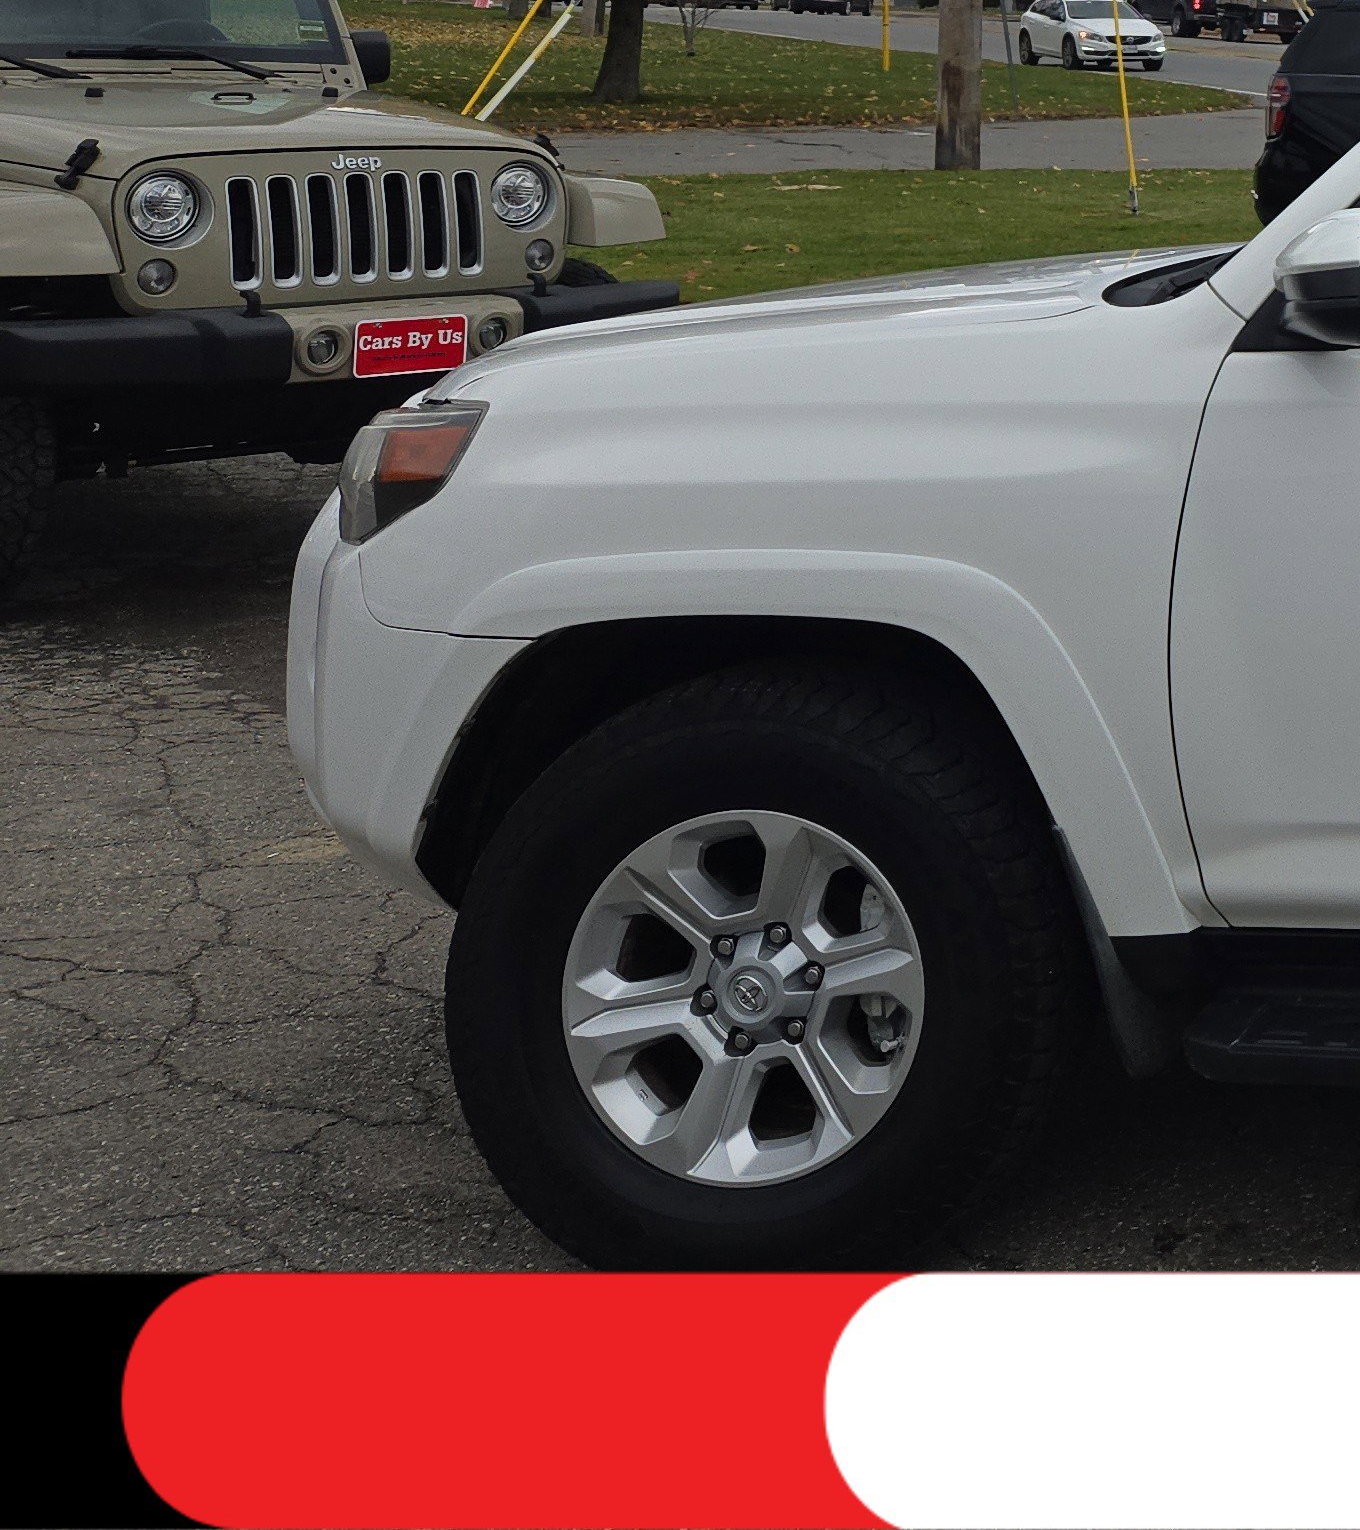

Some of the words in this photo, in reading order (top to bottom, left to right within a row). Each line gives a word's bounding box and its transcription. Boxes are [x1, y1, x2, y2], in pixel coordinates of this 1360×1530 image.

[331, 153, 382, 171] Jeep
[359, 335, 402, 351] Cars
[407, 331, 433, 350] By
[438, 329, 463, 345] Us
